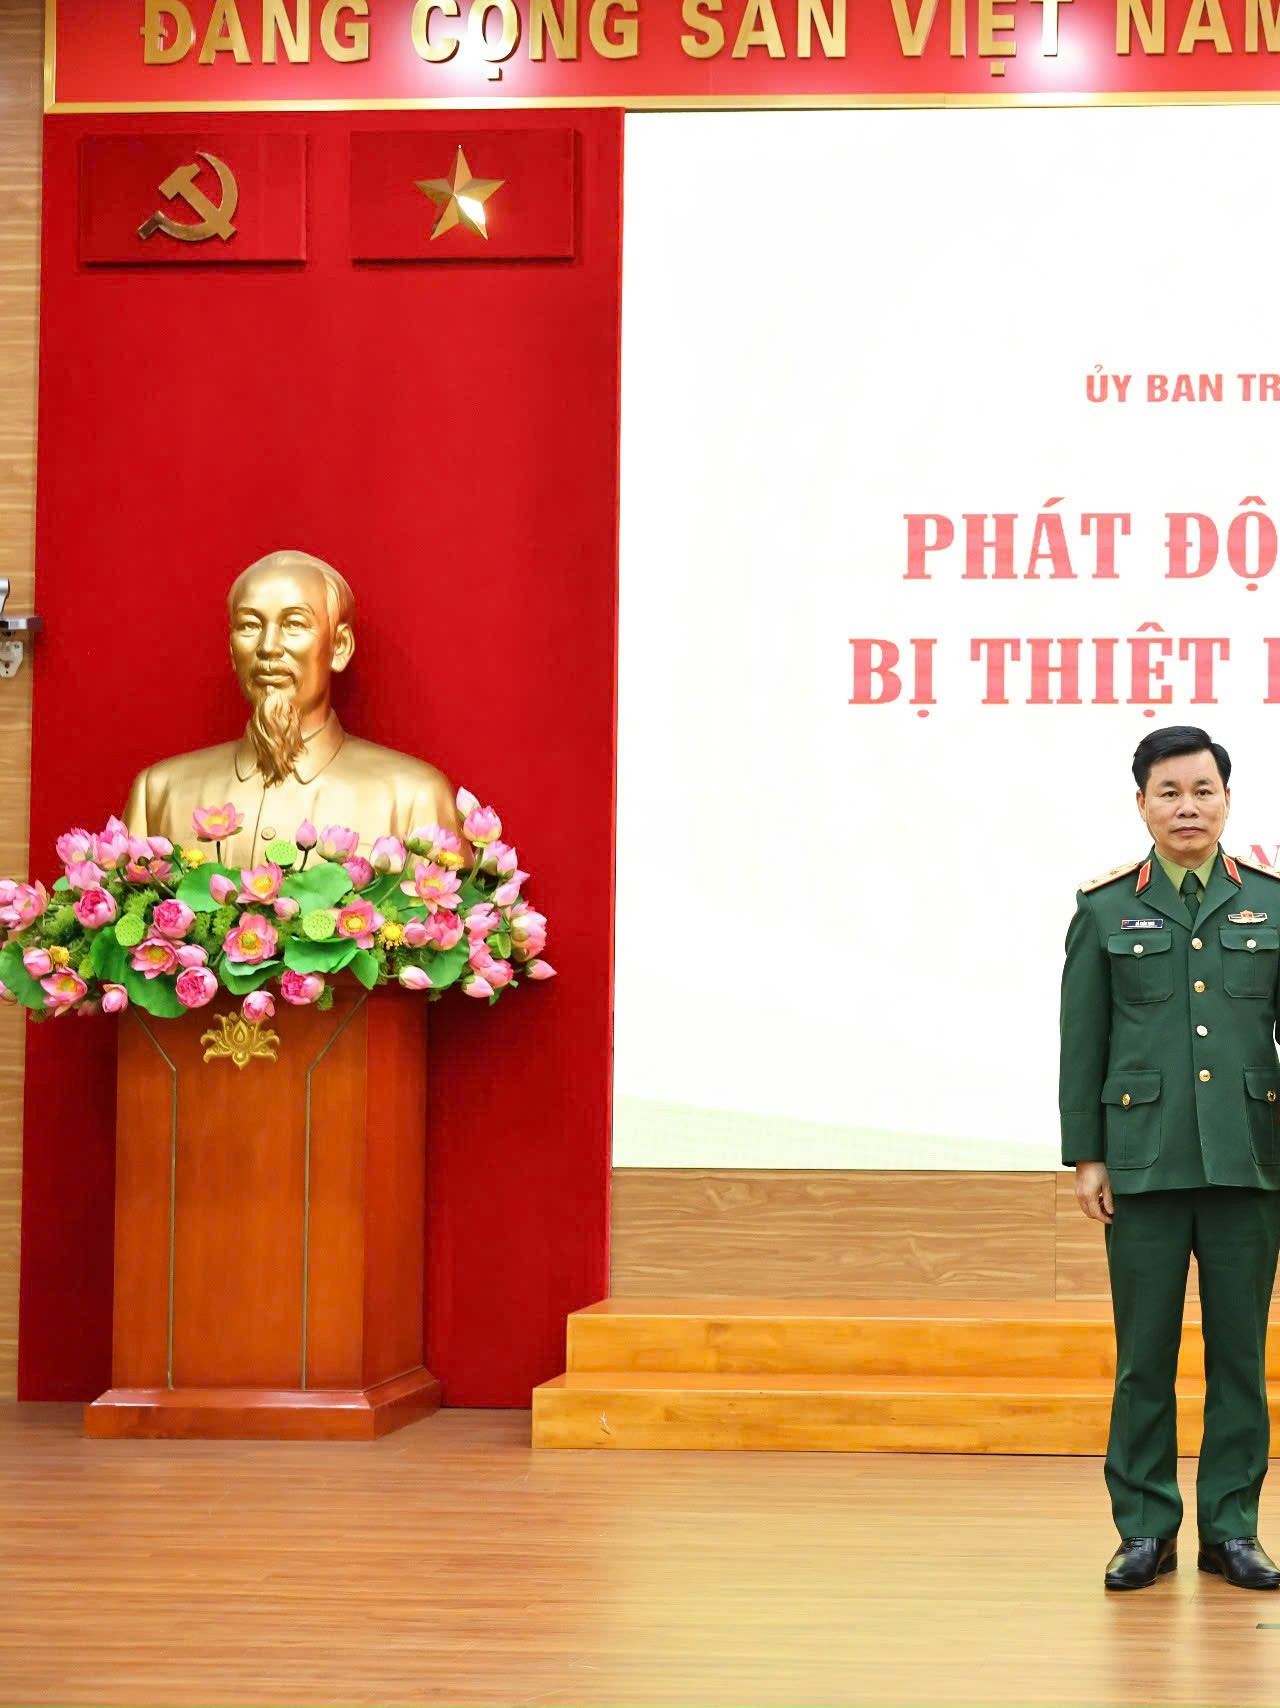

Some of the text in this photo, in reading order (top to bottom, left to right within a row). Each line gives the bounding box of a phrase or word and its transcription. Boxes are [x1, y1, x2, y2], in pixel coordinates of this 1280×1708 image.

[1086, 364, 1132, 403] ỦY
[1147, 373, 1223, 403] BAN
[903, 496, 1132, 580] PHÁT
[848, 638, 938, 719] BỊ
[969, 621, 1231, 718] THIỆT
